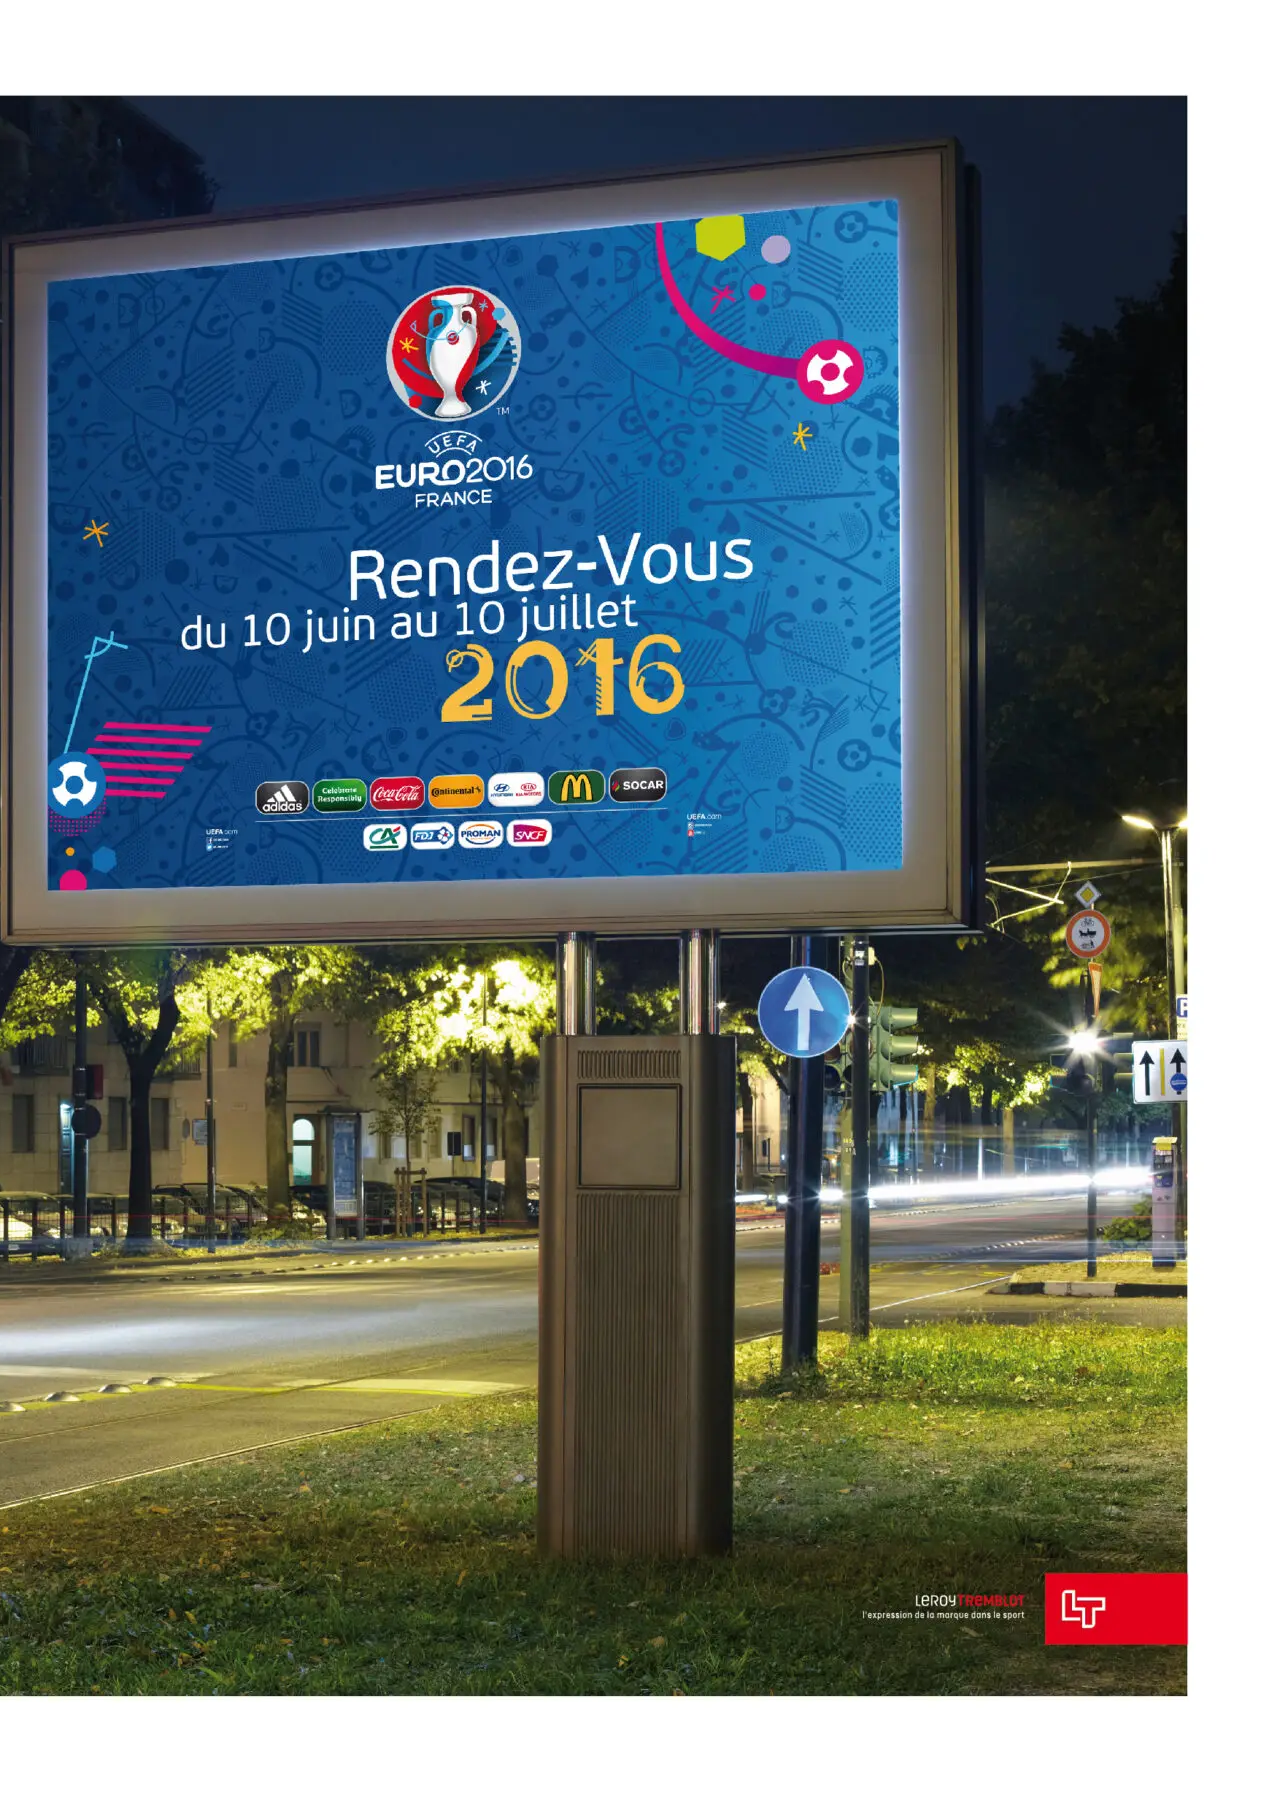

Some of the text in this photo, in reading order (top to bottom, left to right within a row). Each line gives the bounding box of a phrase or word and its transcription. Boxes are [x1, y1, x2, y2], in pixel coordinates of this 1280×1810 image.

[427, 434, 477, 455] UEFA
[415, 489, 493, 508] FRANCE
[350, 532, 754, 601] Rendez-Vous
[181, 592, 639, 652] du 10 juin au 10 juillet
[441, 634, 686, 723] 2016
[623, 780, 664, 790] SOCAR
[322, 787, 358, 795] Celebrate
[317, 795, 362, 804] Responsibly
[262, 802, 303, 813] adidas
[414, 831, 434, 841] FDJ
[461, 828, 501, 838] PROMAN
[514, 830, 546, 840] SNCF
